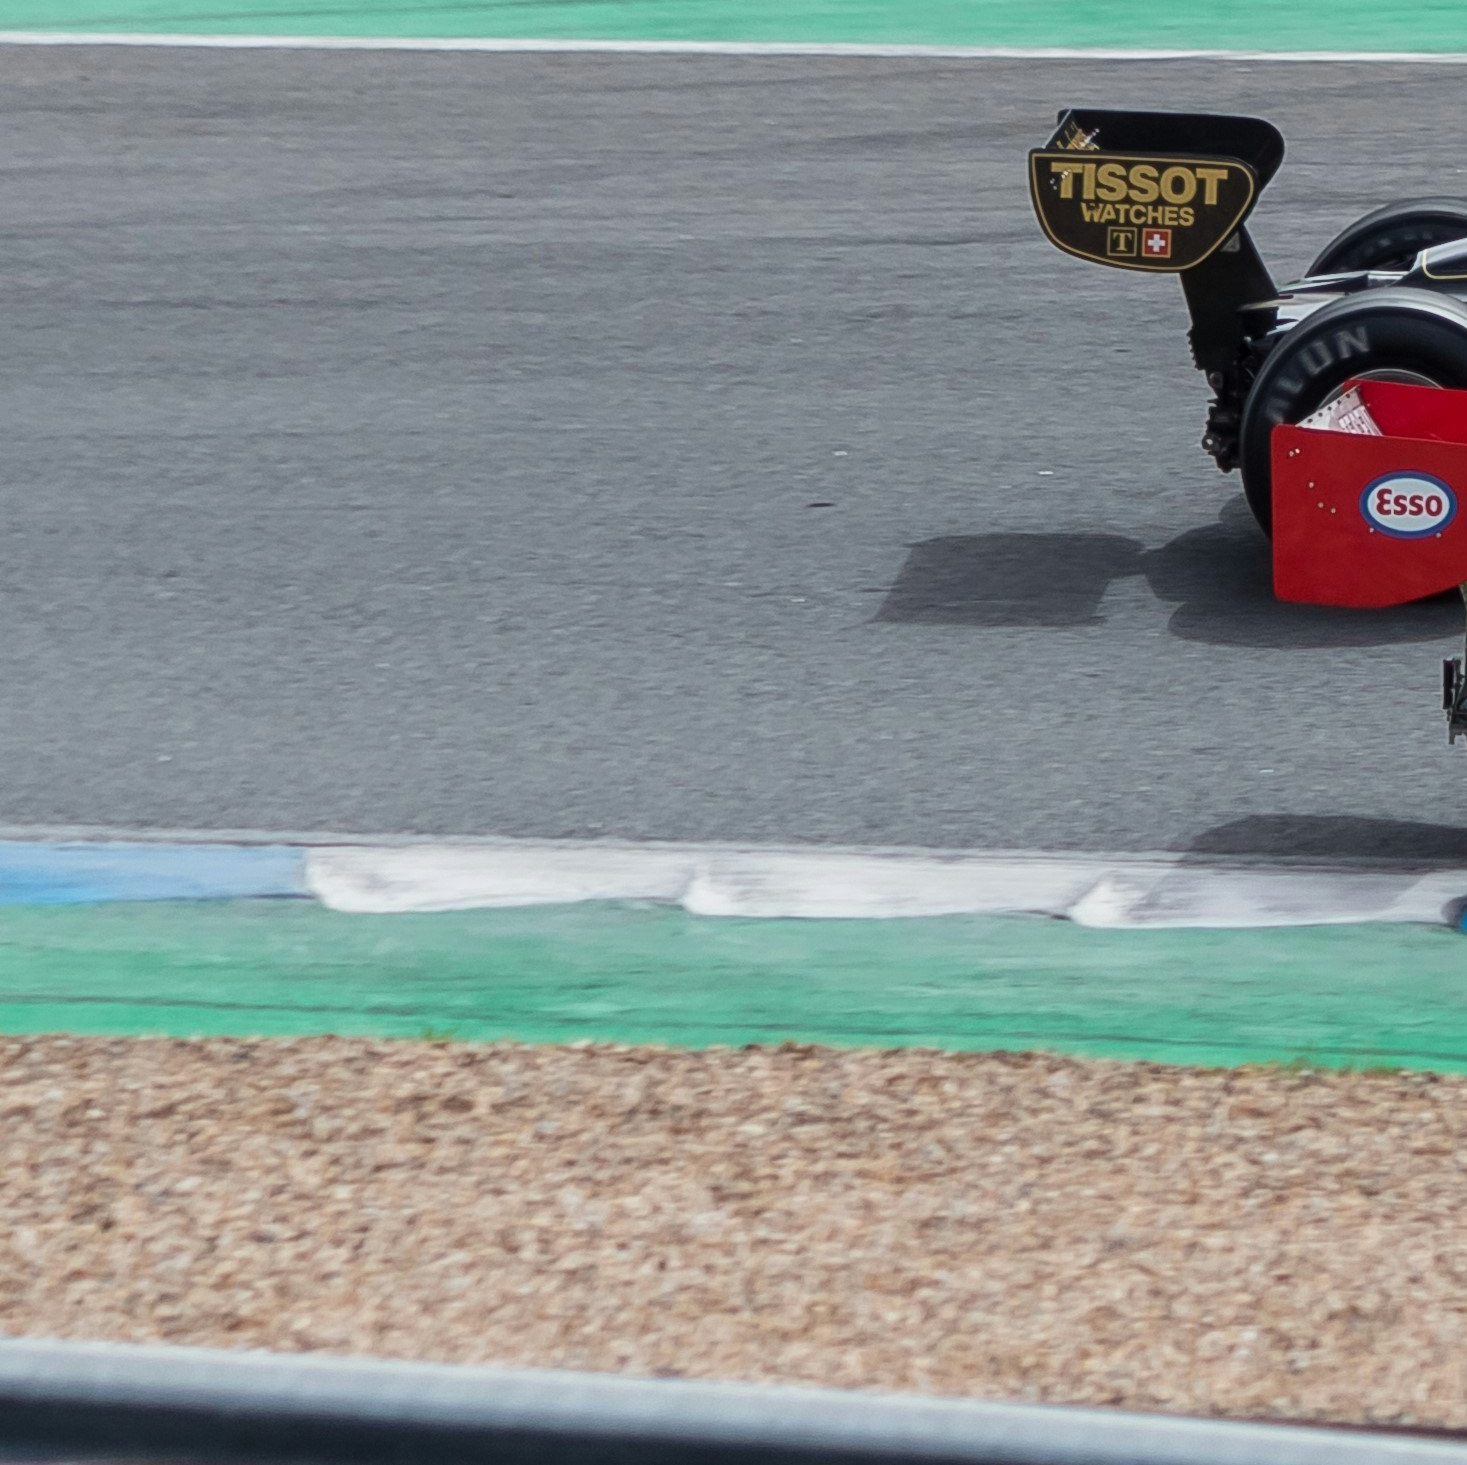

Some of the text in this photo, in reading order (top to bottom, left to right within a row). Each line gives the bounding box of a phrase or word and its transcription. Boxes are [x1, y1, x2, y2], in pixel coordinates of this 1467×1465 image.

[1051, 162, 1228, 205] TISSOT
[1081, 202, 1195, 226] WATCHES
[1113, 232, 1132, 251] T
